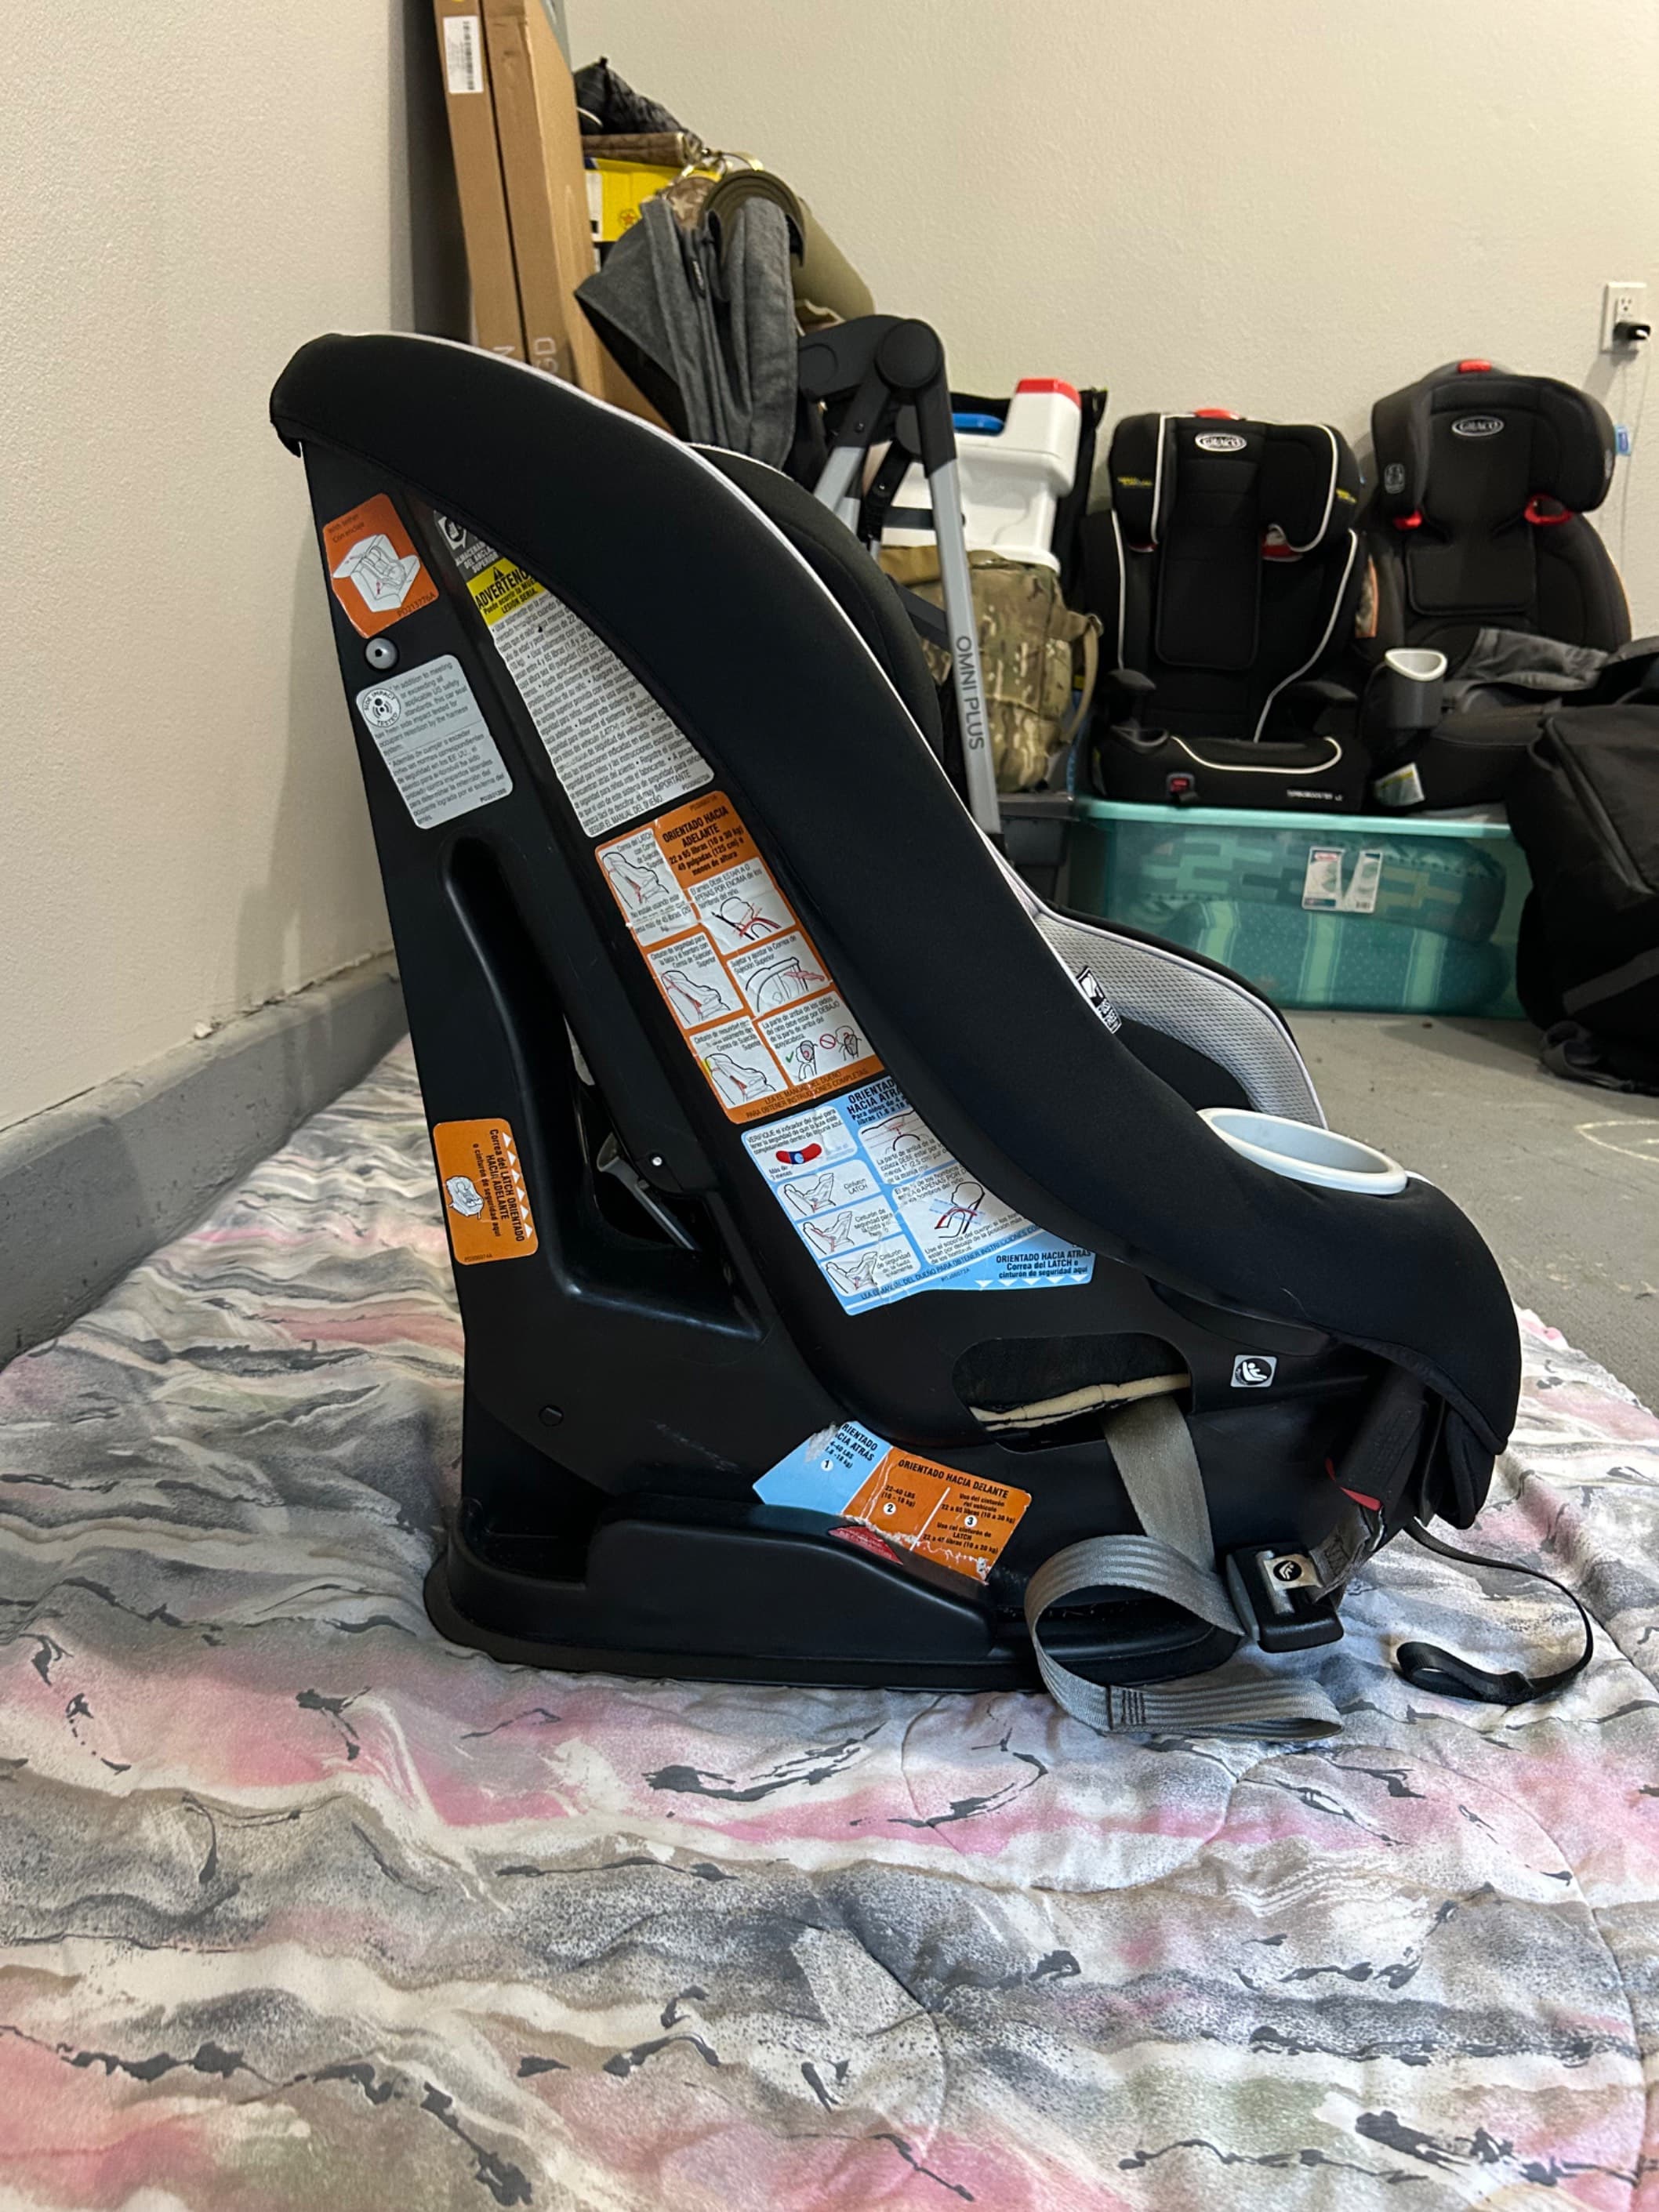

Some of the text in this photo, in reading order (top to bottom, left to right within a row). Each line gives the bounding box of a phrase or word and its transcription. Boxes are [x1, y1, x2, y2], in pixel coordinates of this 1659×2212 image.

[957, 636, 985, 750] OMNI PLUS
[663, 806, 728, 842] ORIENTADO HACIA
[681, 824, 719, 847] ADELANTE
[848, 1079, 895, 1102] ORIENTAD
[848, 1087, 902, 1114] HACIA ATR
[489, 1129, 525, 1242] Correa del LATCH ORIENTADO
[492, 1180, 509, 1220] ADELANTE
[996, 1253, 1039, 1263] ORIENTADO
[1040, 1250, 1065, 1260] HACIA
[1007, 1261, 1032, 1270] Correa
[1047, 1258, 1071, 1267] LATCH
[1037, 1266, 1071, 1277] seguridad
[835, 1431, 874, 1460] CIA ATRÁS
[842, 1423, 877, 1450] RIENTADO
[824, 1459, 830, 1469] 1
[896, 1459, 1010, 1498] ORIENTADO HACIA DELANTE
